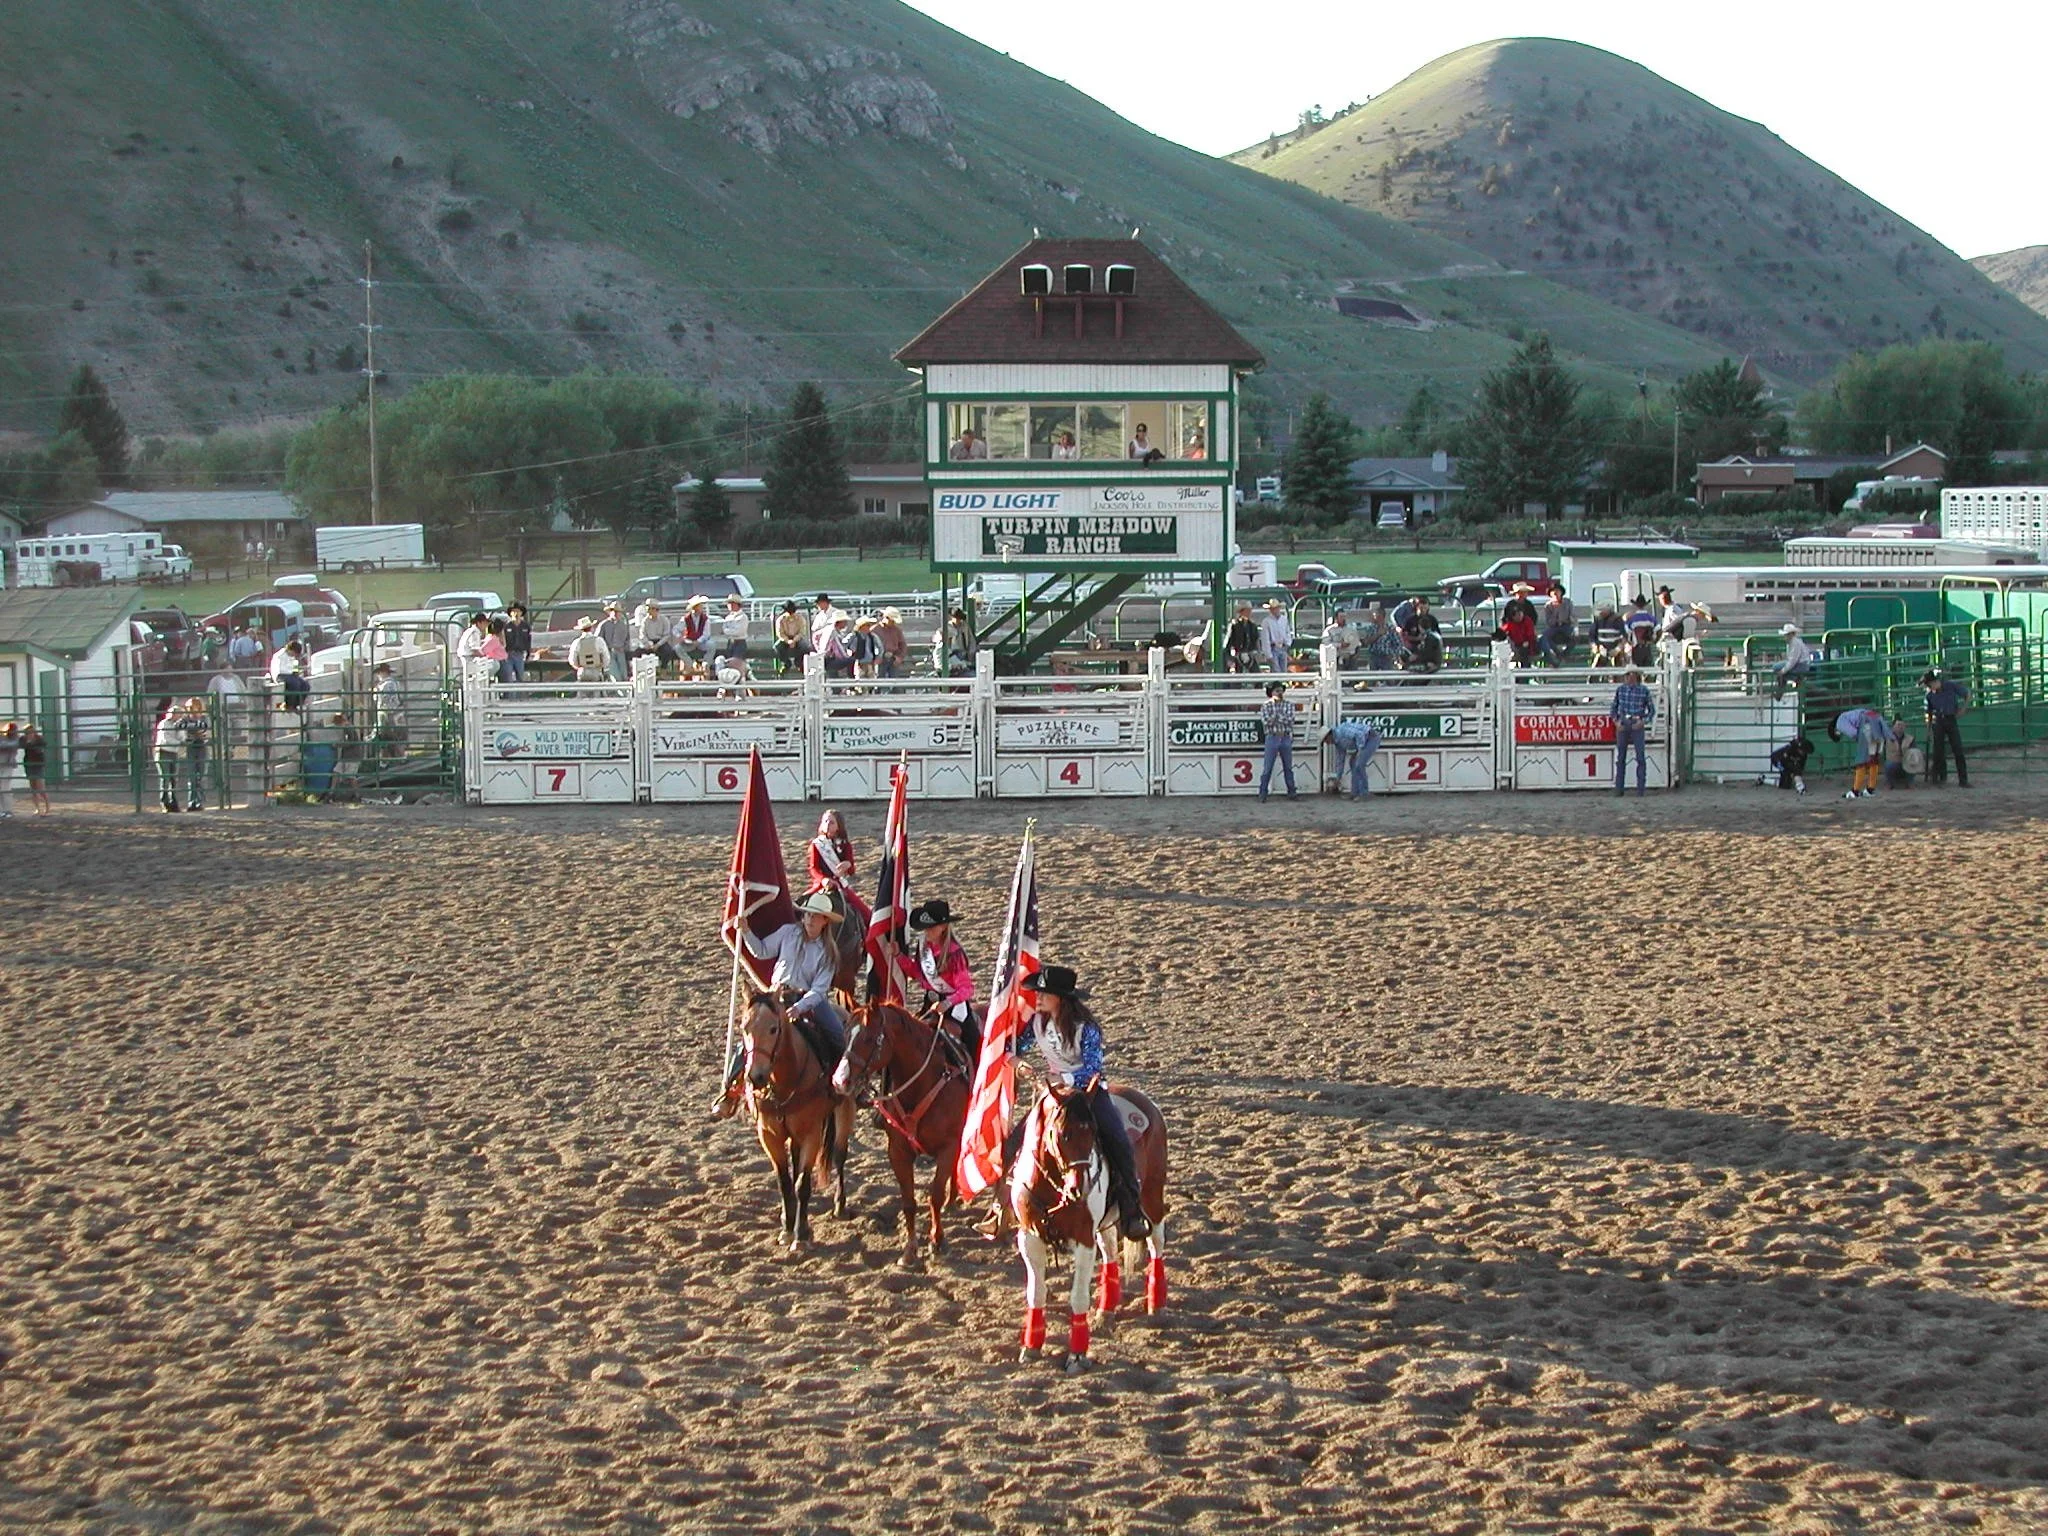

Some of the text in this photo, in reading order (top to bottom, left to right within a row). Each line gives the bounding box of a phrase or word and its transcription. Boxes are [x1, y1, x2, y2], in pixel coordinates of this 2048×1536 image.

[939, 494, 1060, 509] BUD LIGHT
[1102, 487, 1145, 501] Coors
[1177, 488, 1210, 499] Miller
[986, 517, 1173, 534] TURPIN MEADOW
[1045, 536, 1122, 554] RANCH
[1017, 720, 1101, 736] PUZZLEFACE
[1185, 721, 1256, 732] JACKSON HOLE
[1444, 717, 1456, 734] 2
[1519, 716, 1611, 728] CORRAL WEST
[535, 732, 589, 743] WILD WATER
[660, 729, 731, 750] VIRGINIAN
[826, 725, 873, 744] TETON
[843, 731, 917, 749] STEAKHOUSE
[932, 728, 945, 745] 5
[1170, 728, 1259, 744] CLOTHIERS
[1532, 729, 1602, 741] RANCHWEAR
[534, 744, 589, 756] RIVER TRIPS
[592, 735, 605, 752] 7
[708, 741, 773, 751] RESTAURNT
[1060, 762, 1081, 785] 4
[1234, 760, 1254, 784] 3
[1408, 757, 1428, 781] 2
[1584, 754, 1597, 777] 1
[548, 769, 567, 792] 7
[718, 766, 738, 790] 6
